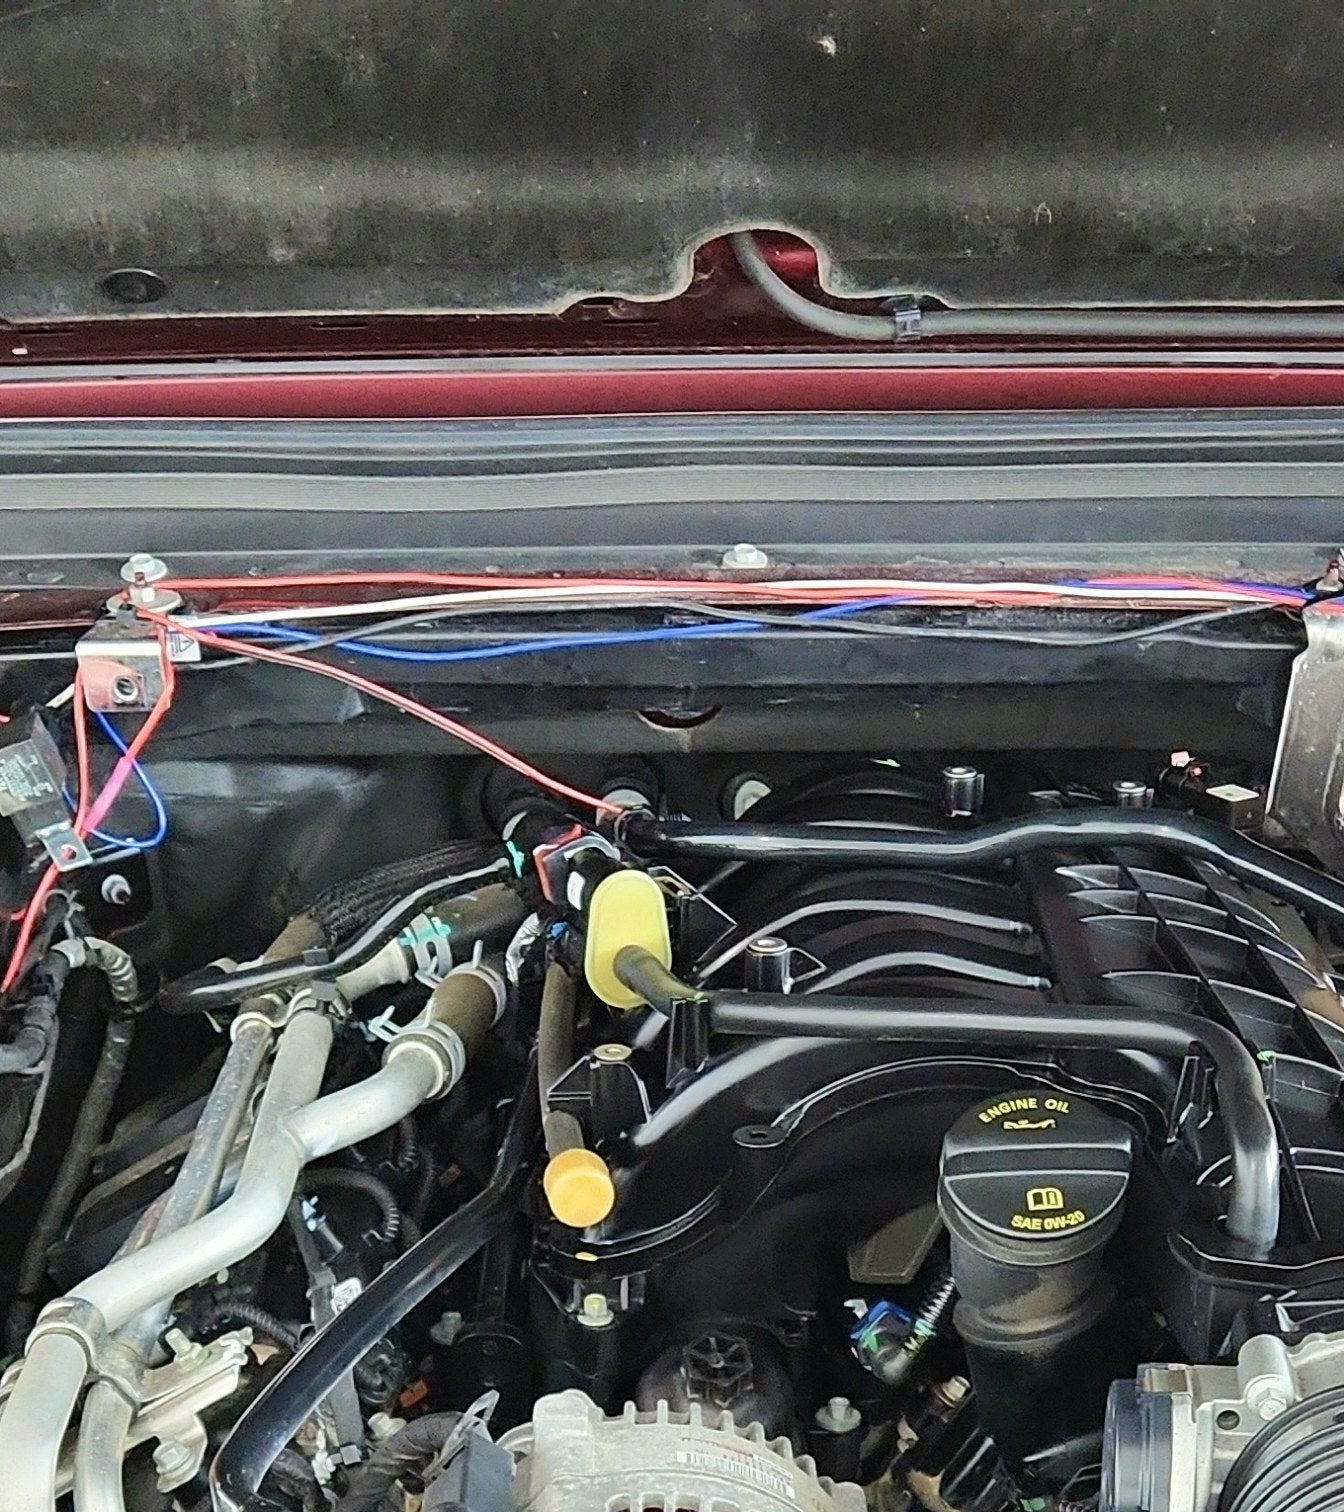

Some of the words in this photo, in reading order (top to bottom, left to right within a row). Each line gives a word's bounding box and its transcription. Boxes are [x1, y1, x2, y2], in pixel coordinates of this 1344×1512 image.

[978, 1097, 1038, 1124] ENGINE
[1044, 1098, 1070, 1114] OIL
[1011, 1214, 1043, 1230] SAE
[1044, 1210, 1086, 1230] 0W-20
